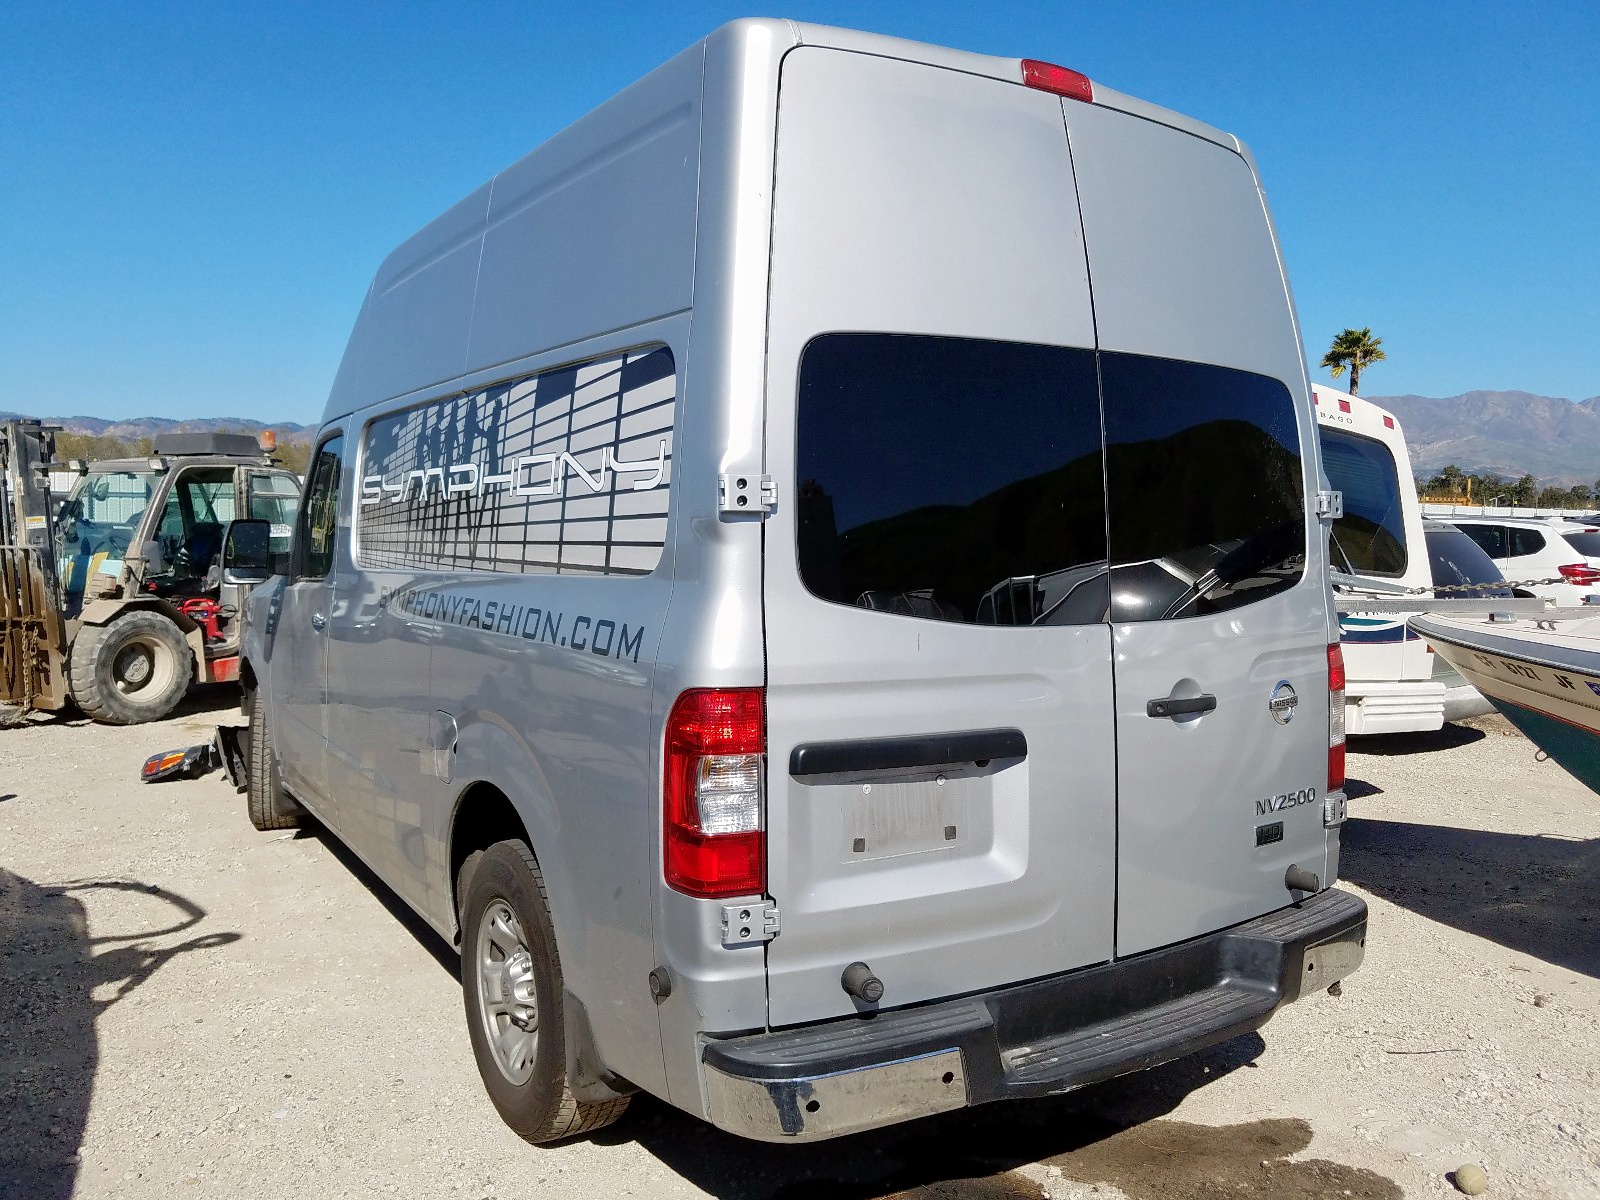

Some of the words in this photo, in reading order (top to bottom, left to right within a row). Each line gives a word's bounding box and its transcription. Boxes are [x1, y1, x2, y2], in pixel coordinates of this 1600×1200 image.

[361, 439, 667, 505] SYMPHONY
[379, 585, 645, 664] SYMPHONYFASHION.COM
[1254, 787, 1316, 816] NV2500
